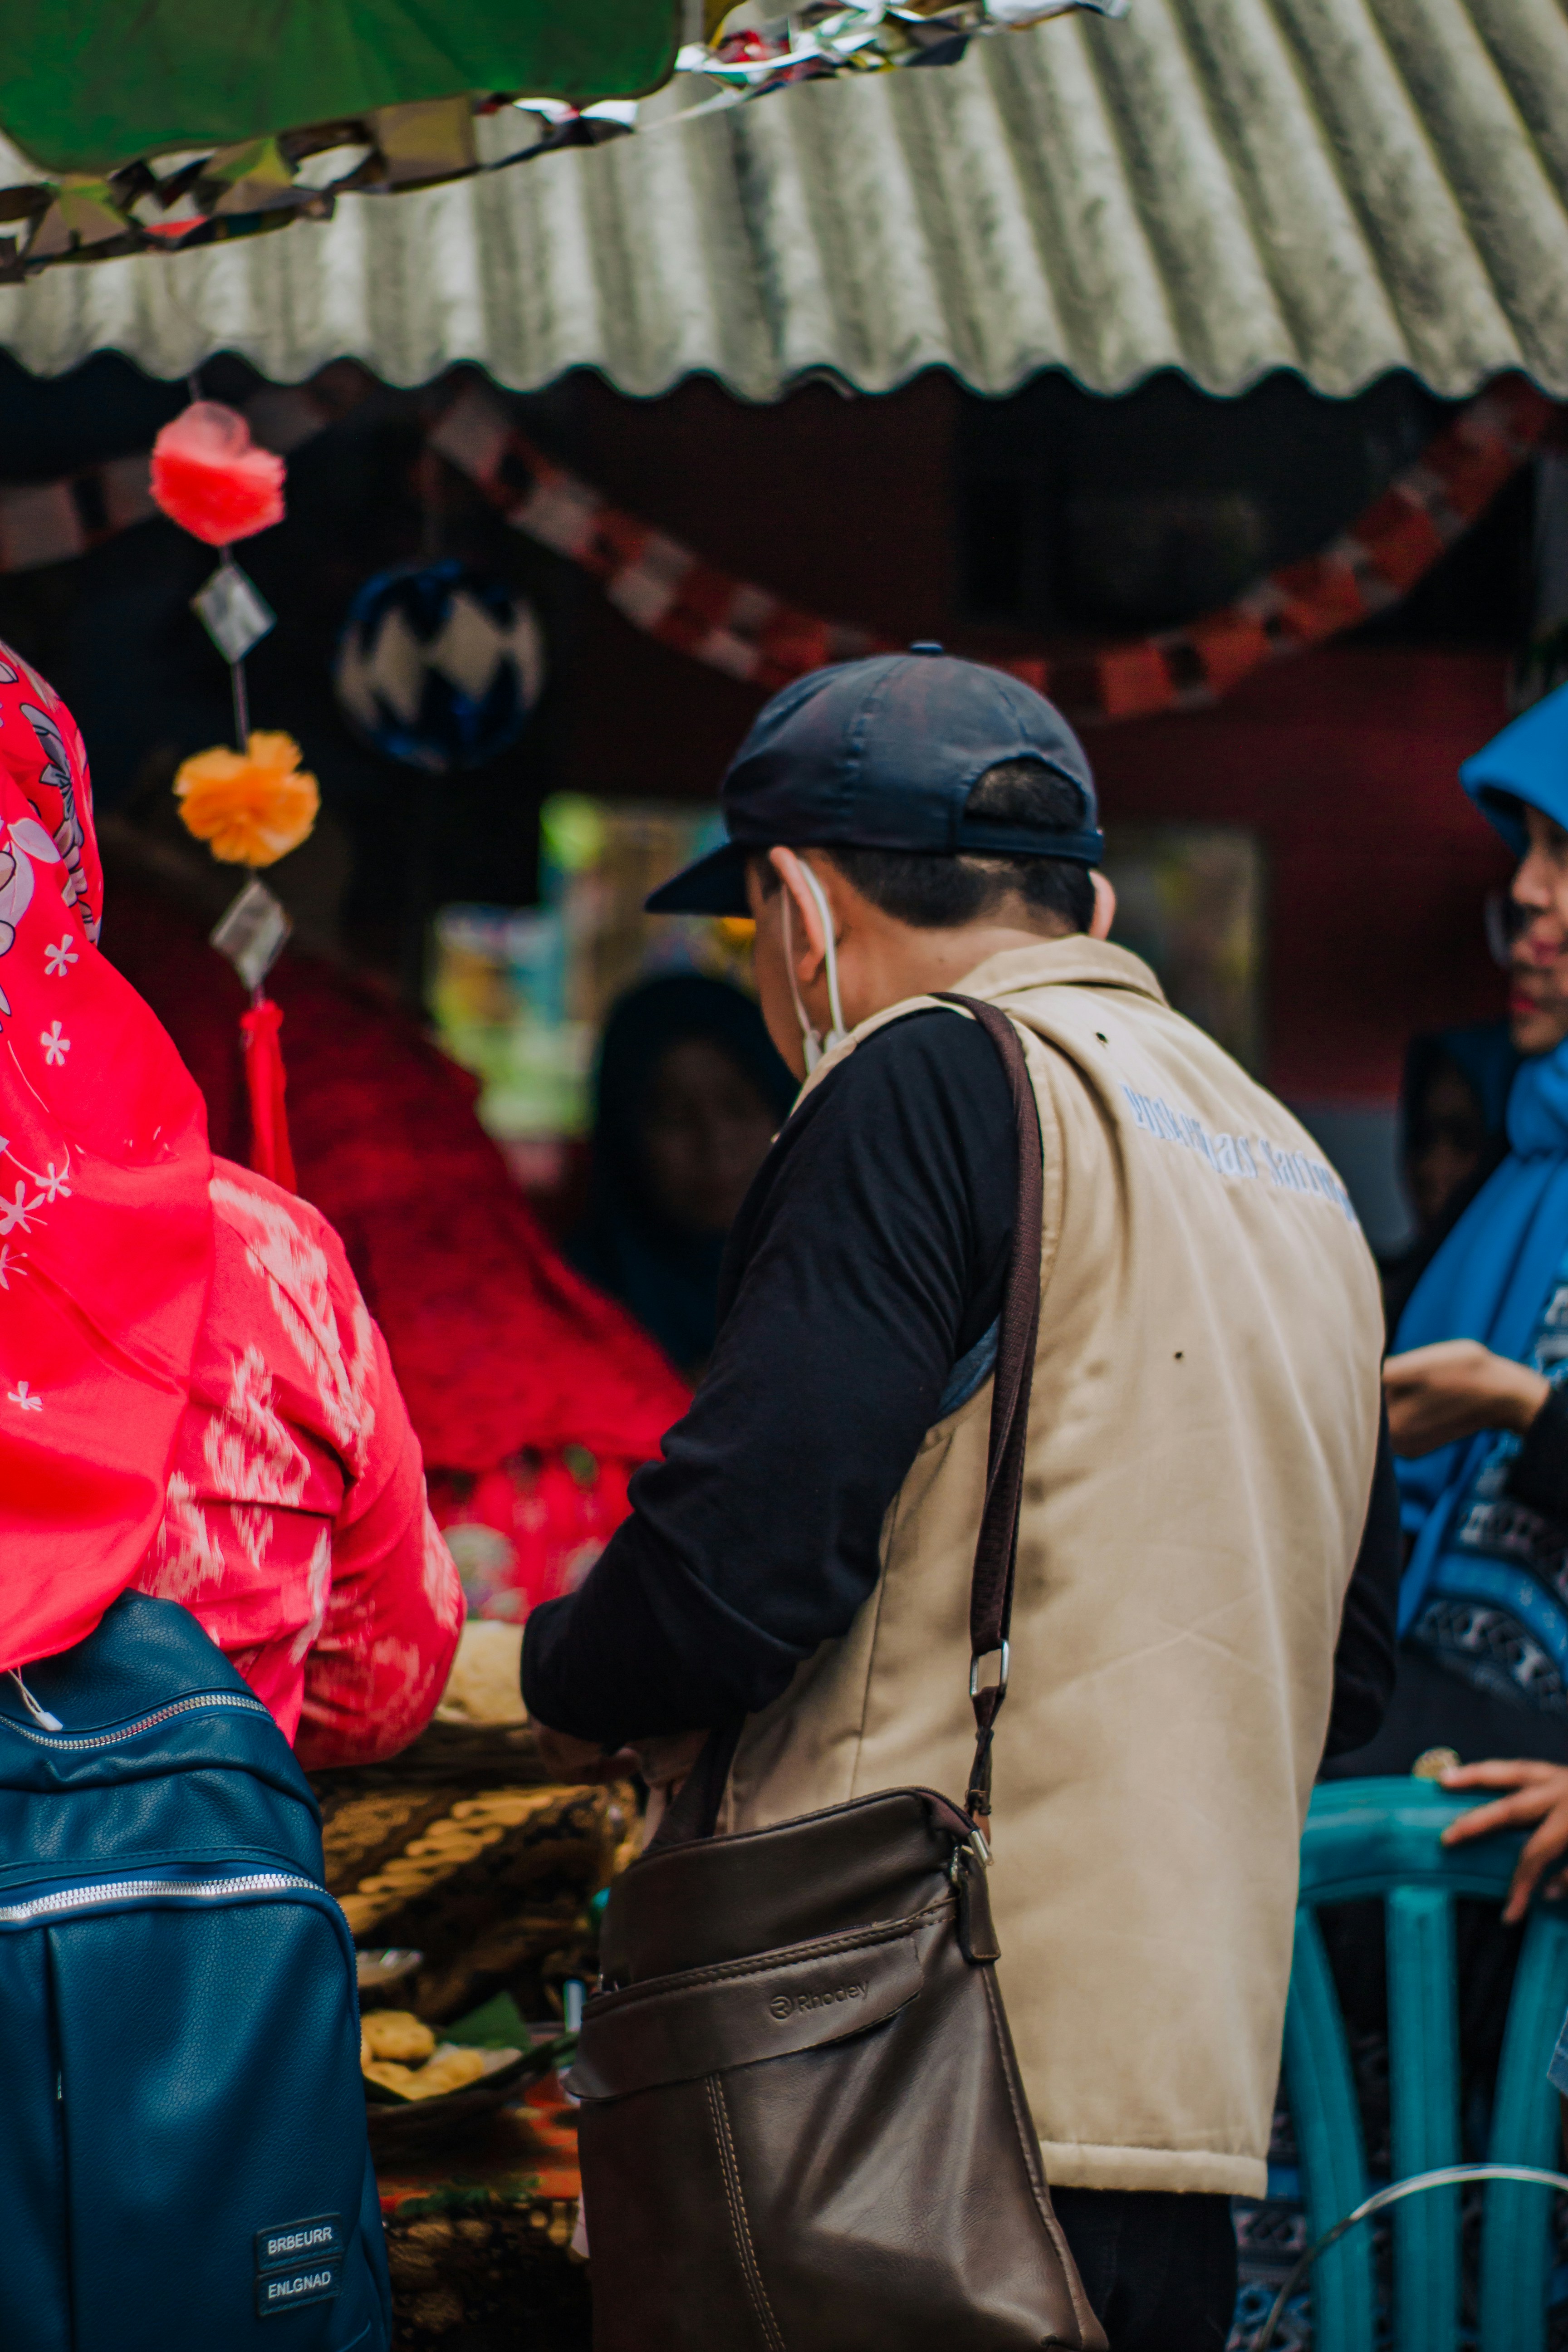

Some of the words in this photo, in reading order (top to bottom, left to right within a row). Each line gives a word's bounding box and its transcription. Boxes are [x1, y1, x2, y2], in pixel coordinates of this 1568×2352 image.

[797, 1980, 869, 2012] Rhodey
[268, 2226, 333, 2255] BRBEURR
[268, 2271, 332, 2299] ENLGNAD
